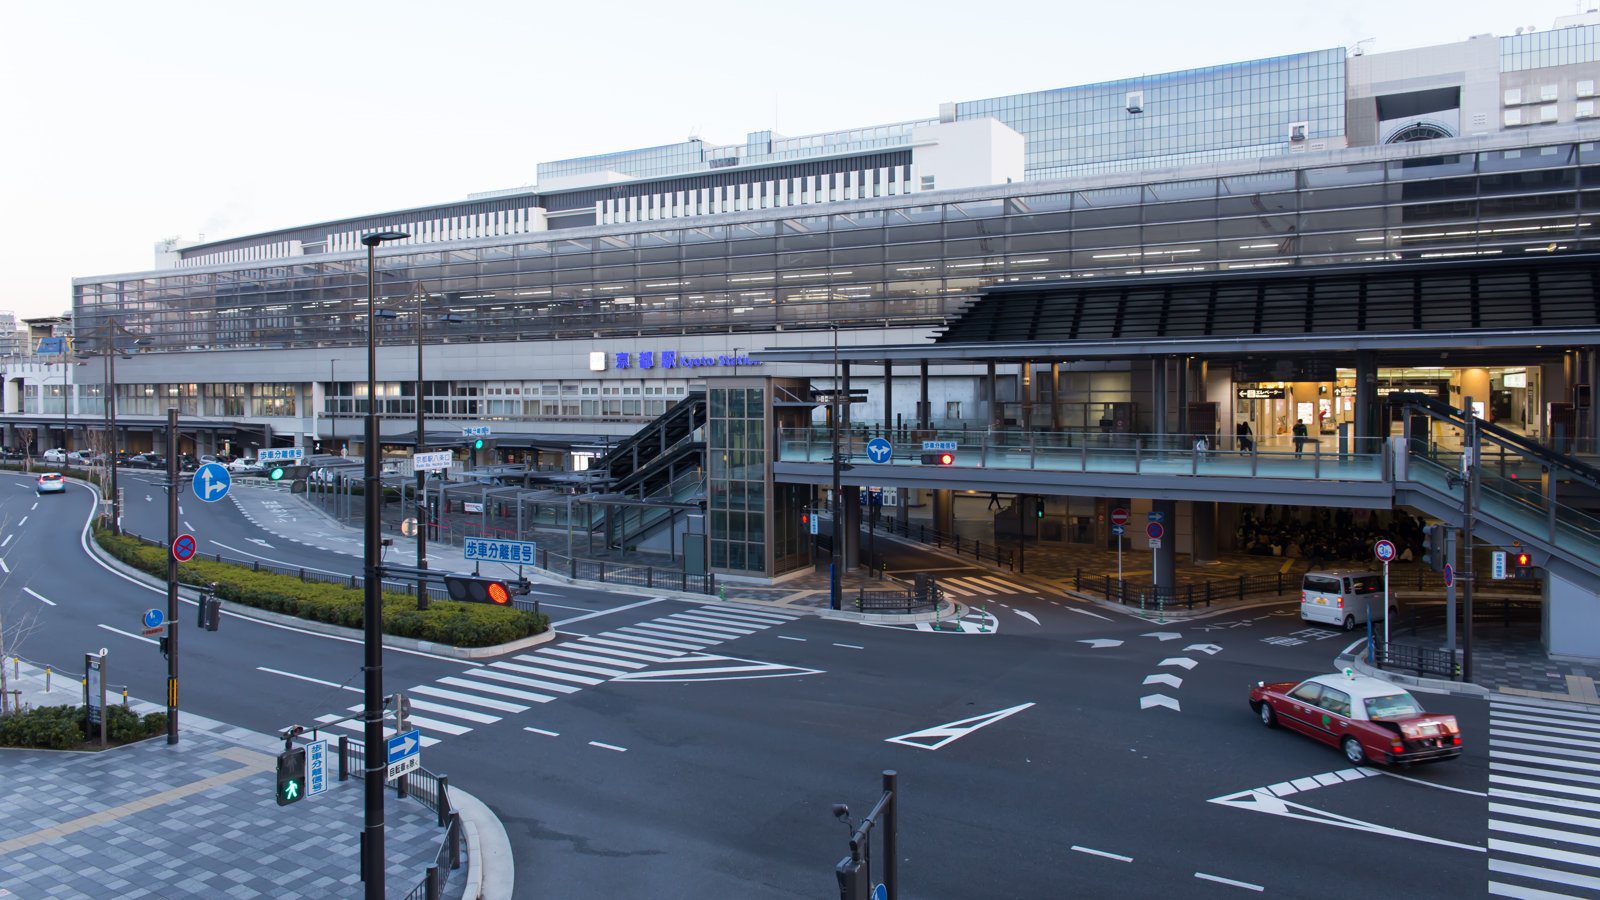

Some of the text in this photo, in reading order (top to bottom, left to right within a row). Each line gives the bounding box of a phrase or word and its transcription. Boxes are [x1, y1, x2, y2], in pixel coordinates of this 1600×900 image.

[615, 351, 677, 369] 京都駅
[680, 355, 715, 369] Kyoto
[467, 541, 532, 561] 歩車分離信号
[312, 744, 323, 791] 歩車分離信号
[390, 758, 419, 777] 自転車を除く
